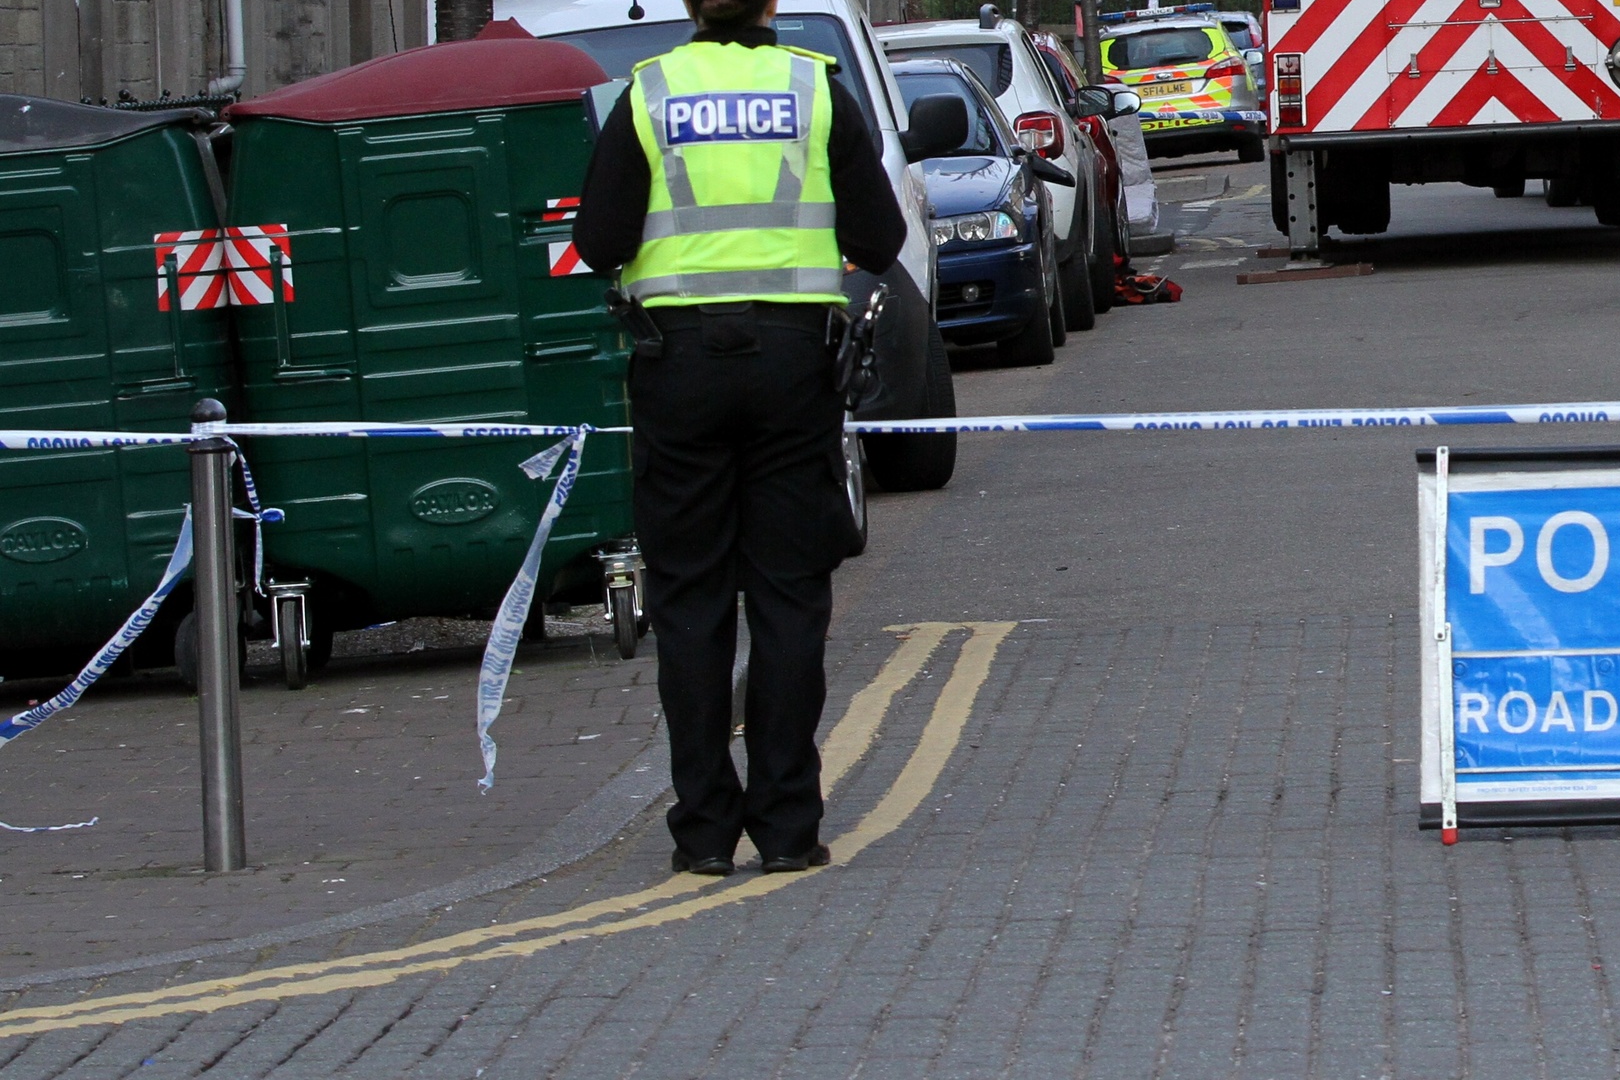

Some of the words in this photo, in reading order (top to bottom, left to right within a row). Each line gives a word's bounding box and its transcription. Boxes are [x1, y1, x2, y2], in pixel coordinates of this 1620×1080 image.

[1138, 8, 1174, 17] POLICE
[669, 98, 793, 139] POLICE
[1459, 690, 1619, 735] ROAD
